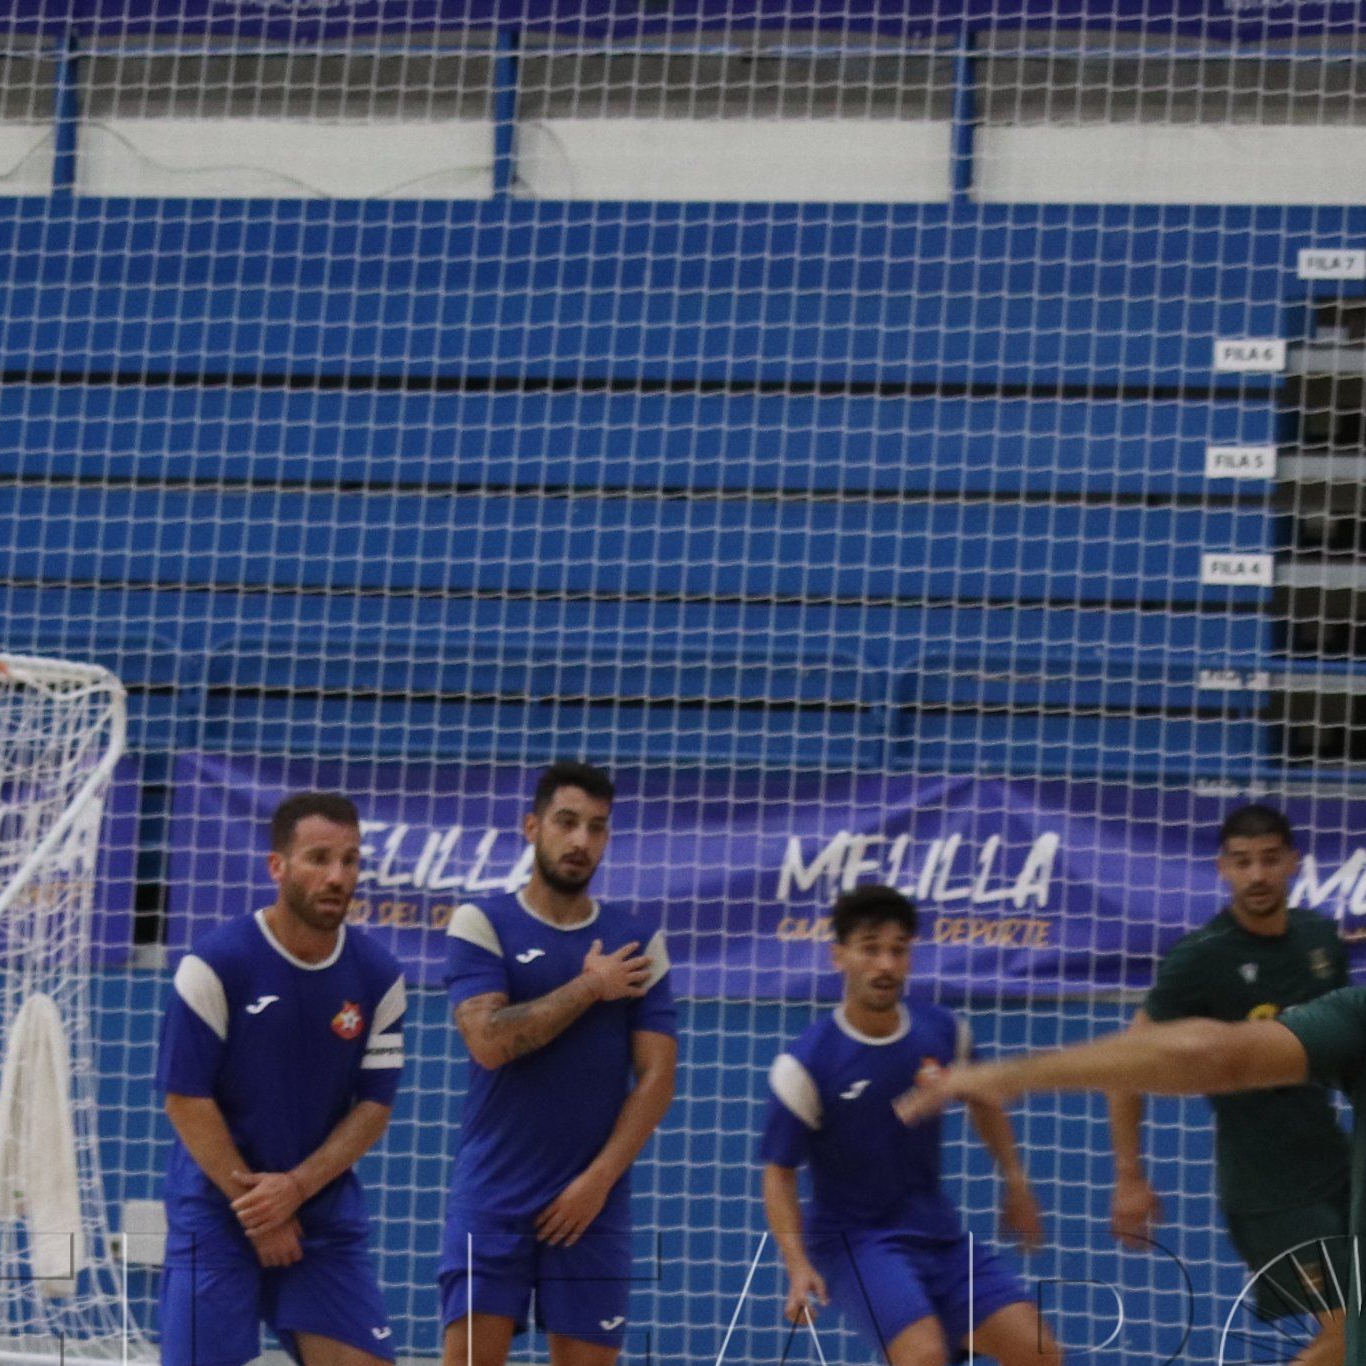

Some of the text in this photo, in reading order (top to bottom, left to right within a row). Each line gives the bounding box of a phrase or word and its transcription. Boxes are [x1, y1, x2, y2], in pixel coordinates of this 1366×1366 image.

[1307, 256, 1356, 271] FILA 7
[1224, 348, 1274, 362] FILA 6
[1214, 453, 1264, 468] FILA 5
[1211, 560, 1245, 575] FILA
[777, 832, 1060, 908] MELILLA
[935, 918, 1052, 947] DEPORTE
